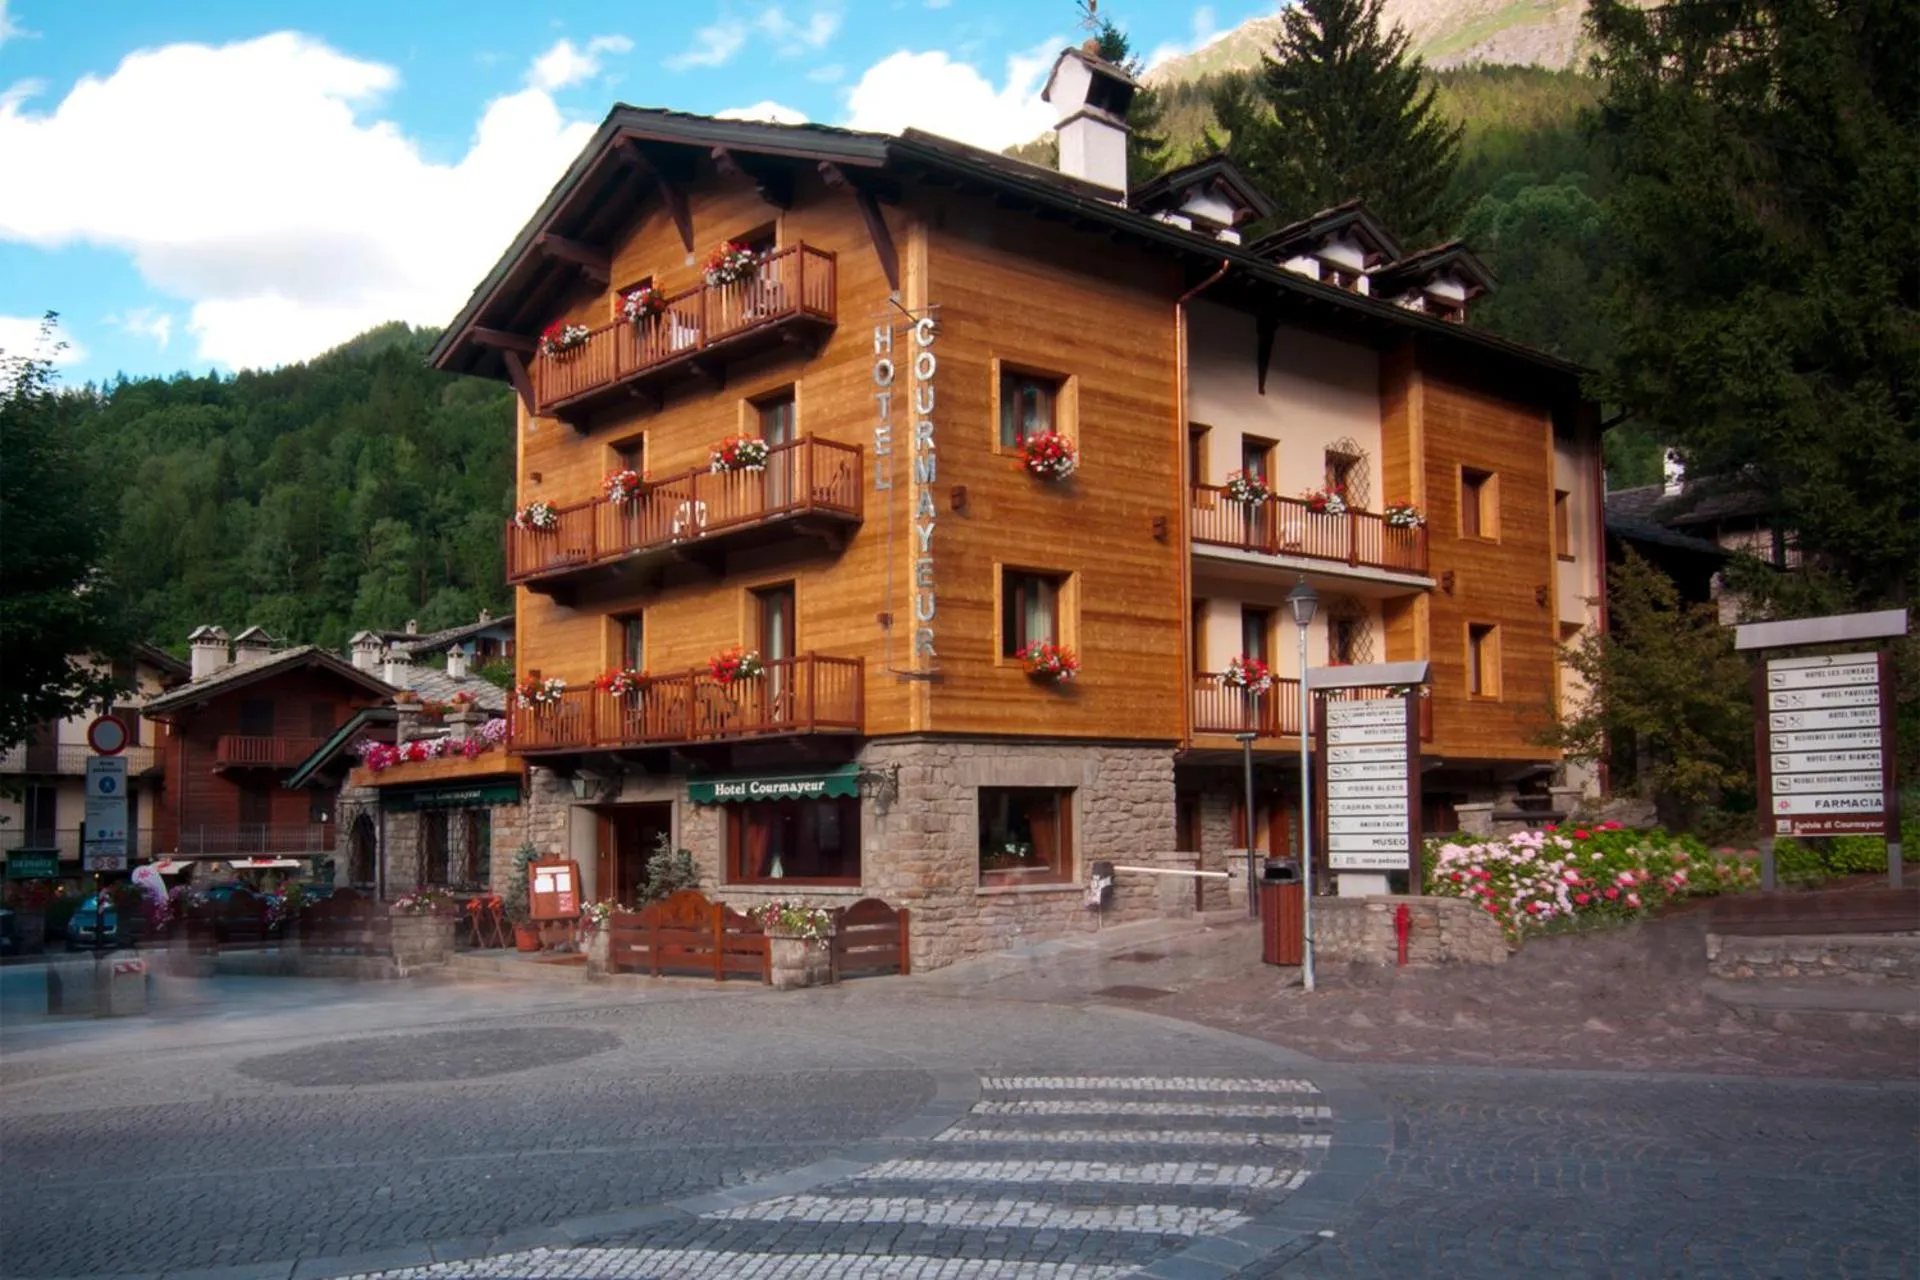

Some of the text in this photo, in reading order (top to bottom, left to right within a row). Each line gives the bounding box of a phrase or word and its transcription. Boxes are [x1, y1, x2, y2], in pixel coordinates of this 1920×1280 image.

[874, 326, 894, 490] HOTEL
[914, 317, 937, 656] COURMAYEUR
[715, 781, 825, 796] Hotel Courmayeur
[1814, 798, 1883, 808] FARMACIA
[1372, 838, 1406, 846] MUSEO
